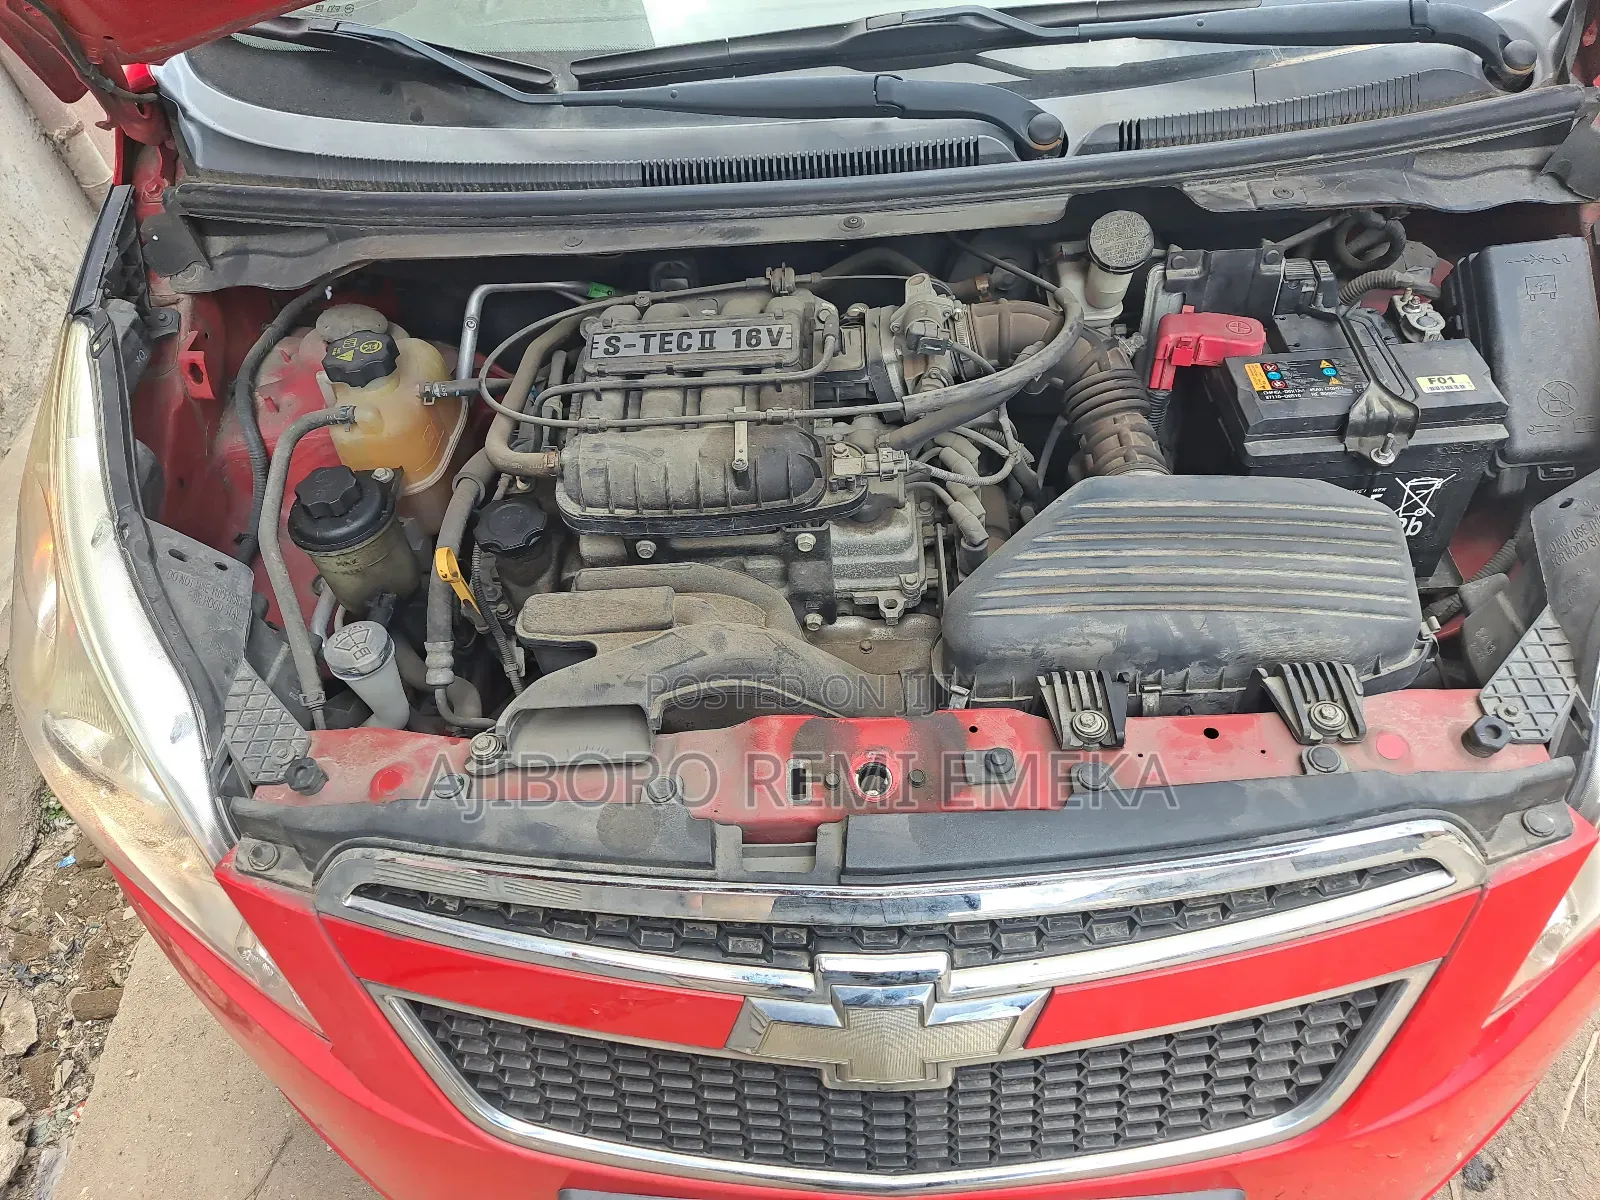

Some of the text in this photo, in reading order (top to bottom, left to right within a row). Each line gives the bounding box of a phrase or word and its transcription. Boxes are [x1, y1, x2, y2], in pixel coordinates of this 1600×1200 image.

[731, 326, 785, 349] 16V
[1427, 376, 1456, 385] F01
[1571, 523, 1589, 540] USE
